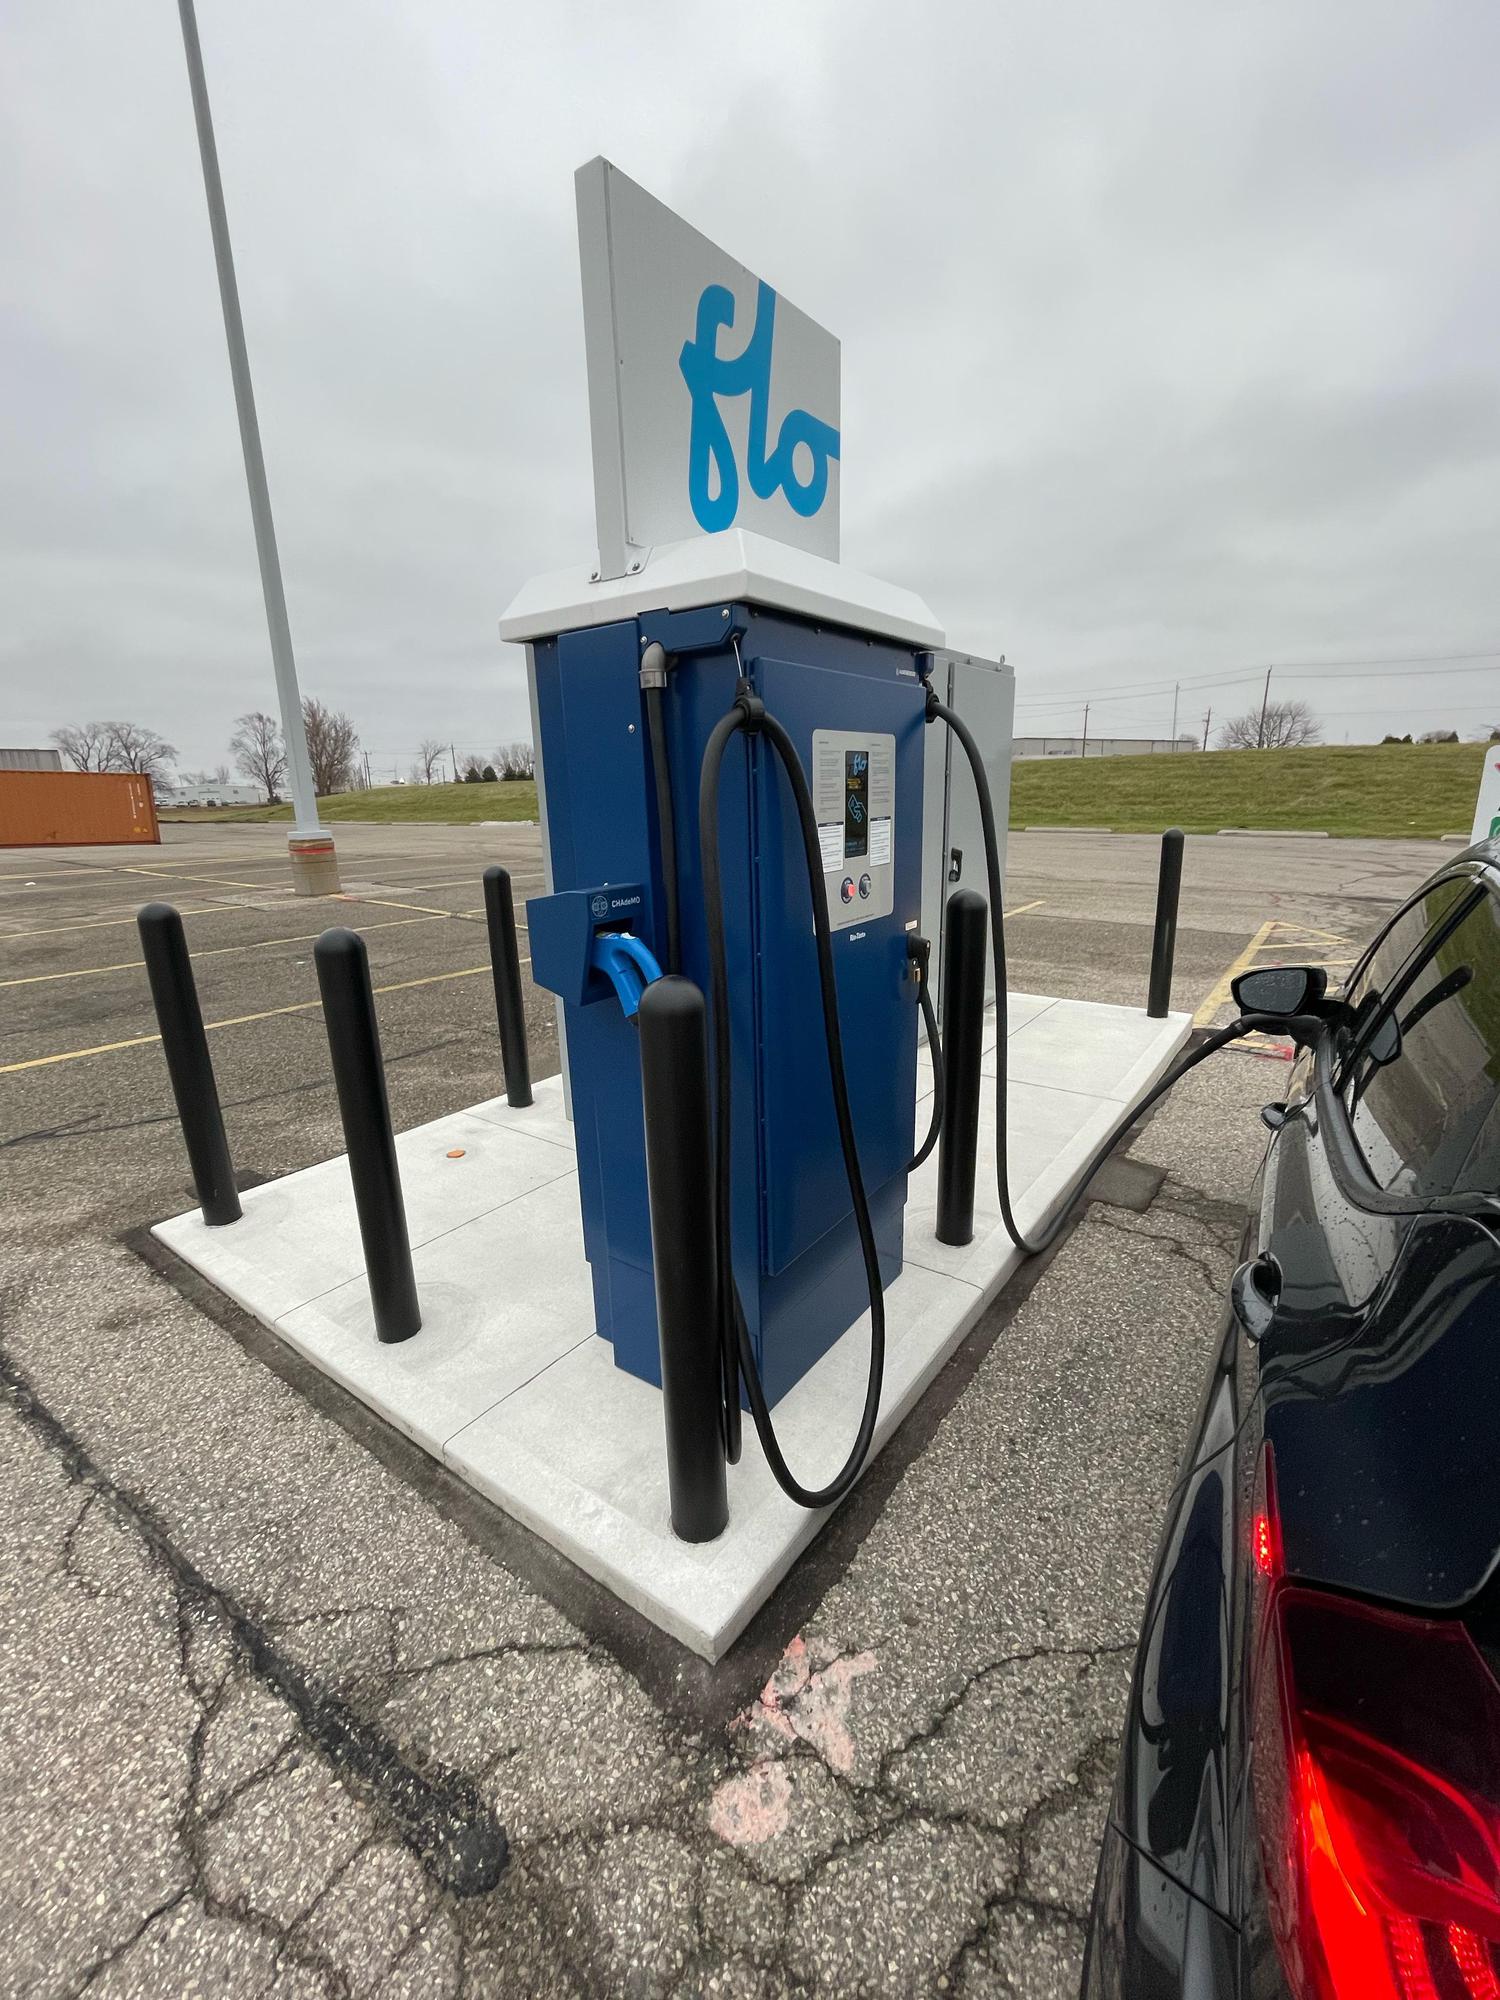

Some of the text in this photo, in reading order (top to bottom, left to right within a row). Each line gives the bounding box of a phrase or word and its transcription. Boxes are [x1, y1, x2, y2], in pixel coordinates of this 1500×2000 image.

[678, 279, 841, 534] flo
[853, 753, 868, 776] flo
[611, 896, 641, 908] CHAdeMO
